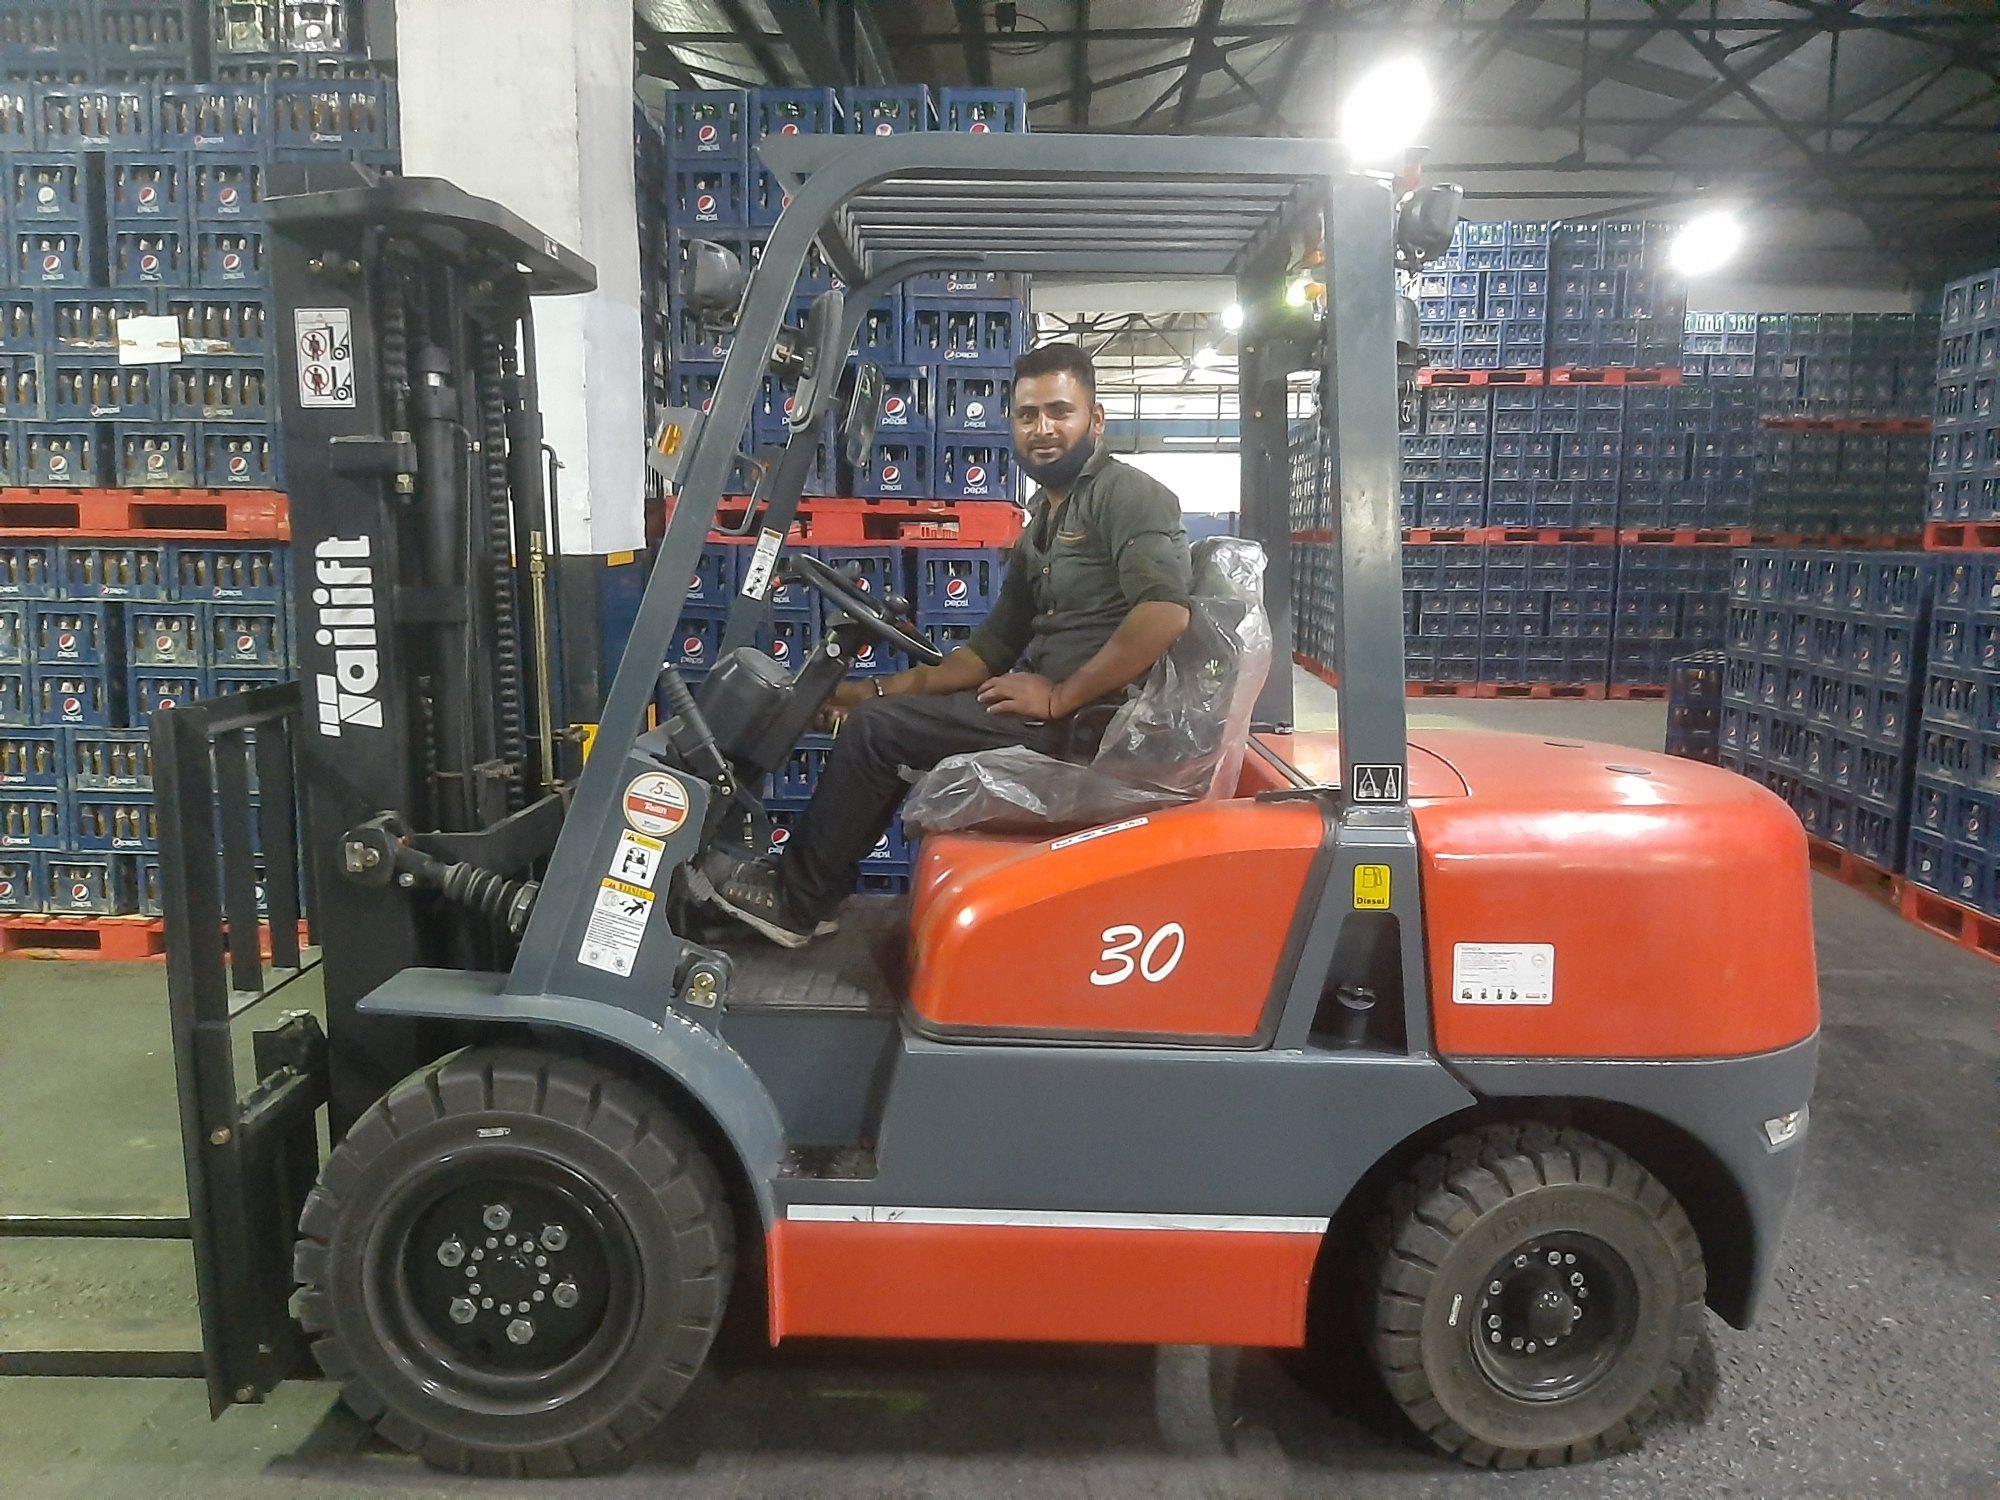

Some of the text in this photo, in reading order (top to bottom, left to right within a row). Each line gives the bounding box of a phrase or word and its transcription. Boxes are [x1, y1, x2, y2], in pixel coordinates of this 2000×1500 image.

[956, 351, 978, 359] pepsi
[882, 417, 907, 425] pepsi
[964, 418, 986, 426] pepsi
[881, 484, 902, 492] pepsi
[964, 486, 988, 495] pepsi
[773, 596, 790, 604] epsi
[944, 599, 969, 608] pepsi
[1357, 897, 1385, 905] Diesel
[1089, 922, 1184, 985] 30
